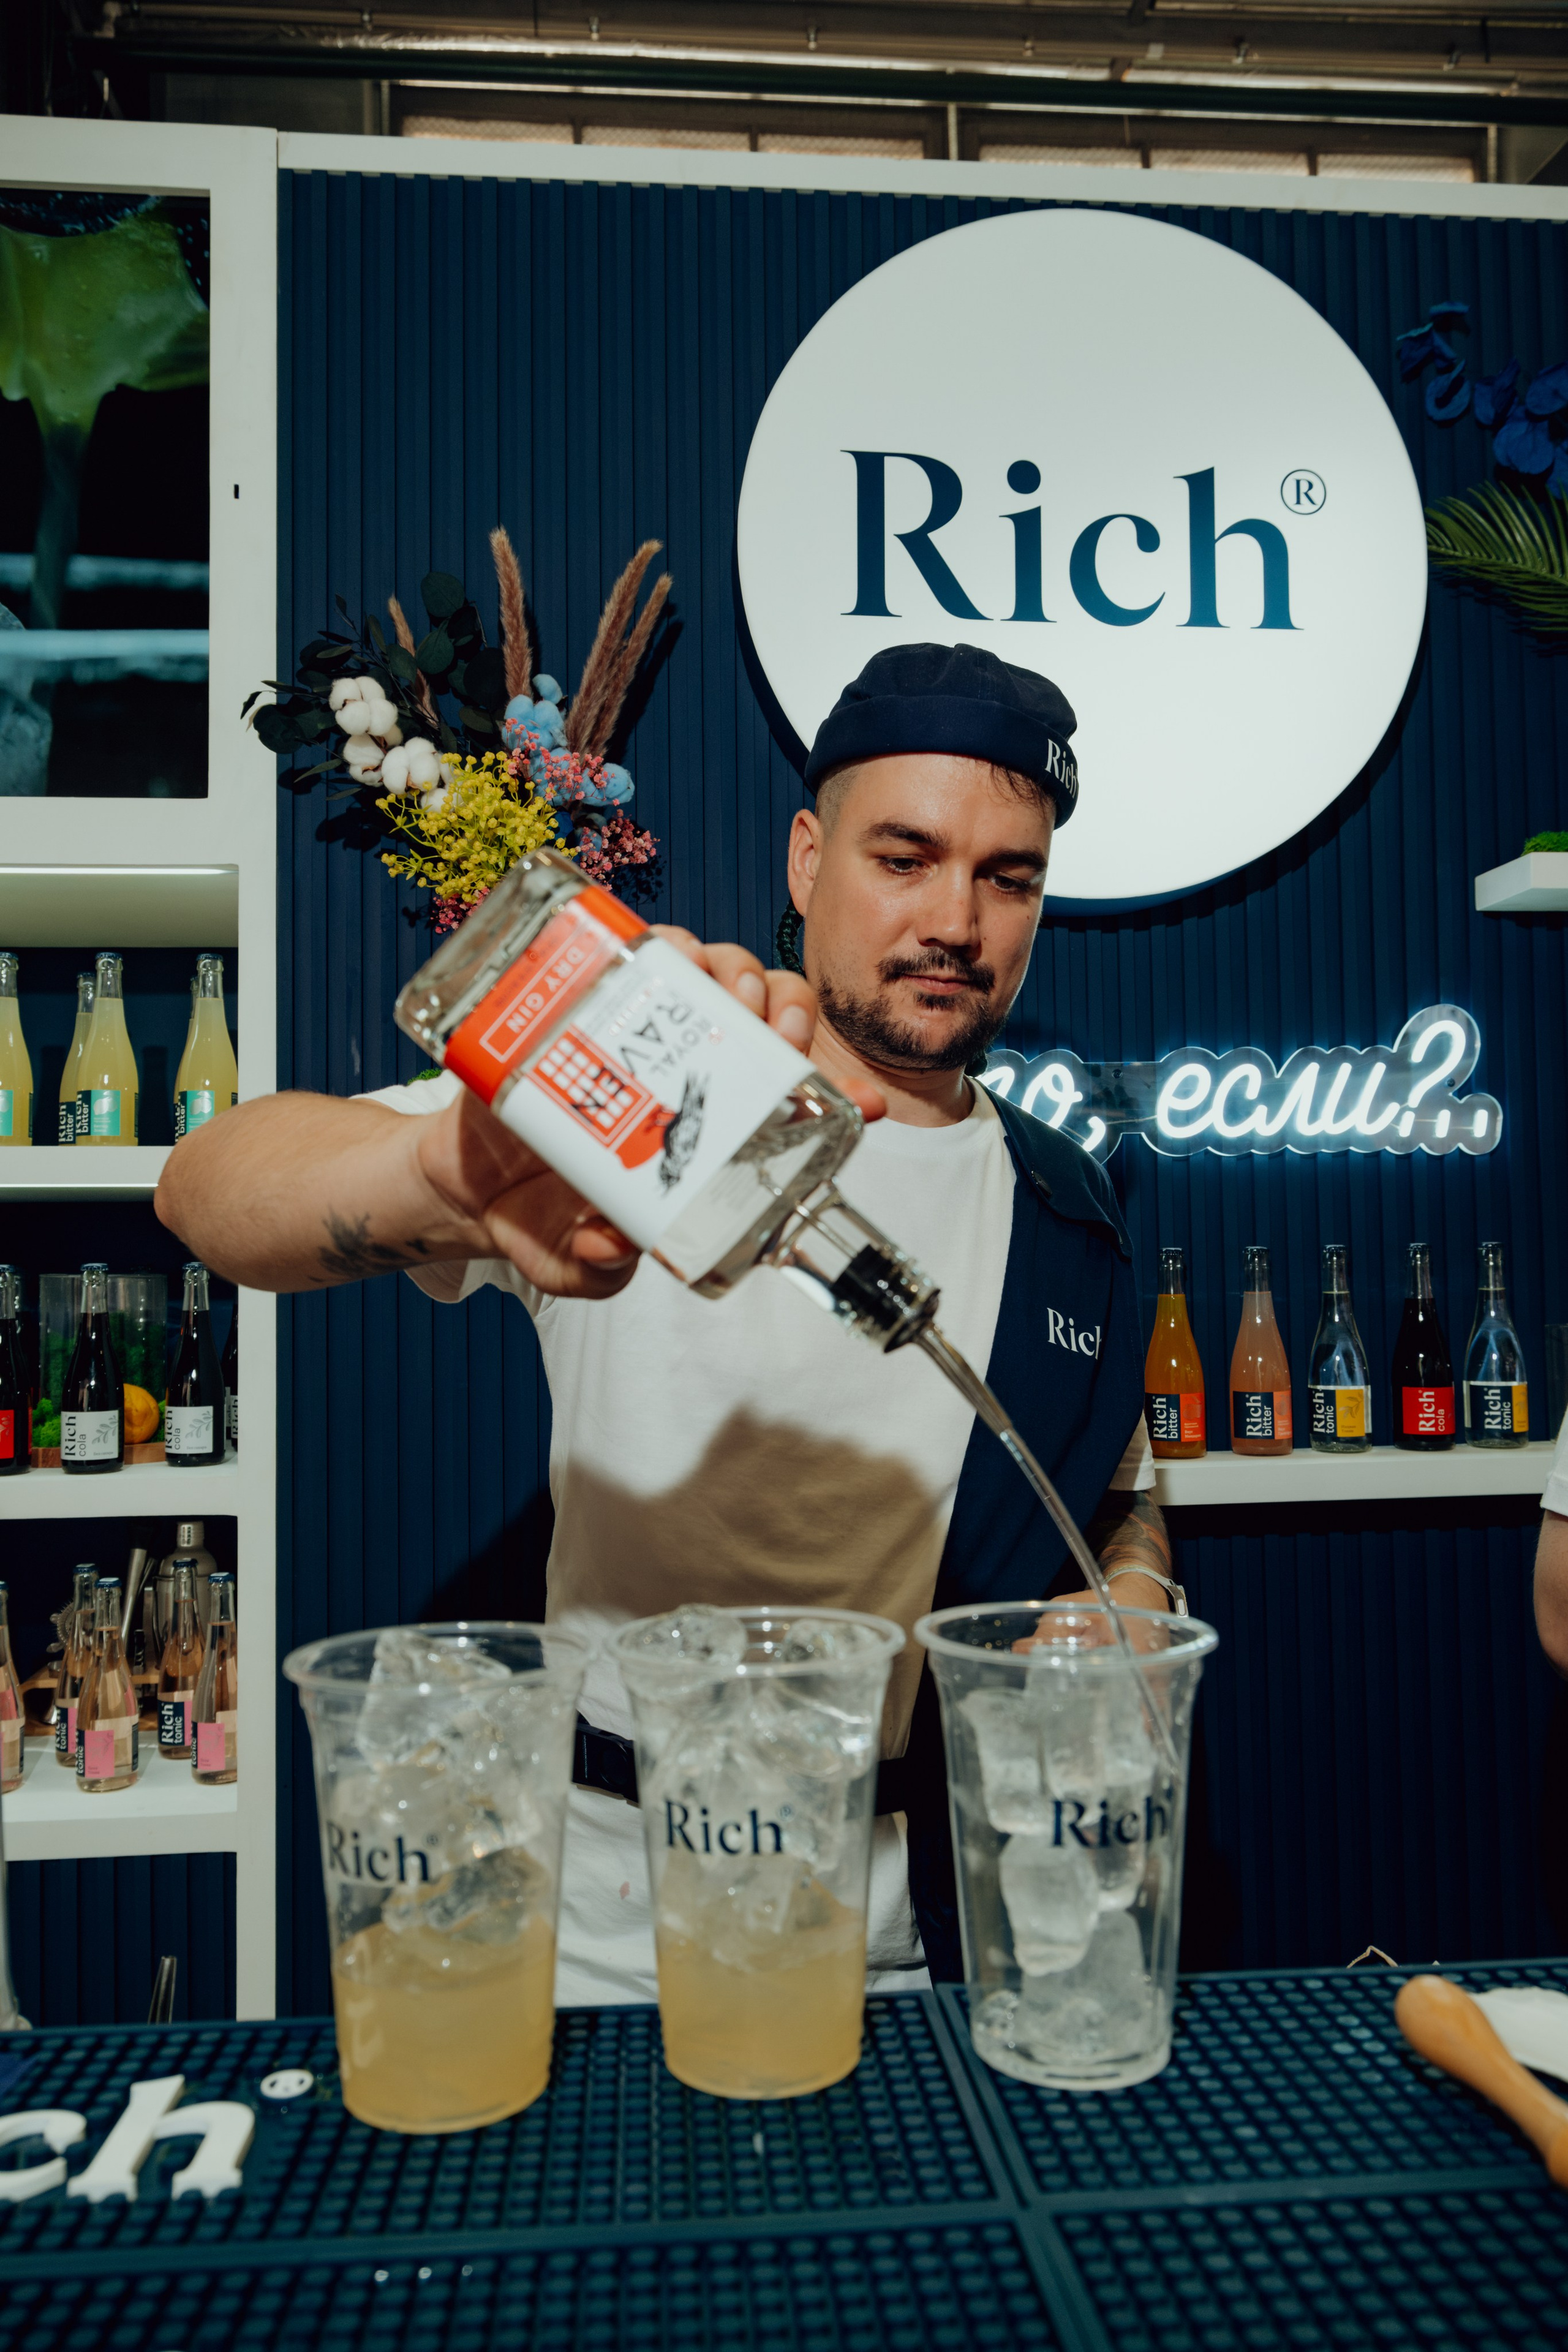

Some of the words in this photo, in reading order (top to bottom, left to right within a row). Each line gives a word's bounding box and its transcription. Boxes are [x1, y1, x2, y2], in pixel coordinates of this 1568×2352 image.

[542, 946, 586, 993] DRY
[505, 992, 545, 1034] GIN
[1152, 1396, 1167, 1439] Rich
[1168, 1408, 1178, 1439] bitter
[1246, 1395, 1262, 1437] Rich
[1262, 1405, 1272, 1436] bitter
[1312, 1391, 1325, 1433] Rich
[1324, 1405, 1335, 1434] tonic
[1418, 1391, 1436, 1432] Rich
[1435, 1409, 1446, 1432] cola
[1483, 1389, 1502, 1430] Rich
[1501, 1401, 1512, 1430] tonic
[64, 1415, 76, 1456] Rich
[77, 1434, 86, 1457] cola
[161, 1703, 174, 1744] Rich
[173, 1716, 183, 1744] tonic
[1049, 1795, 1169, 1849] Rich
